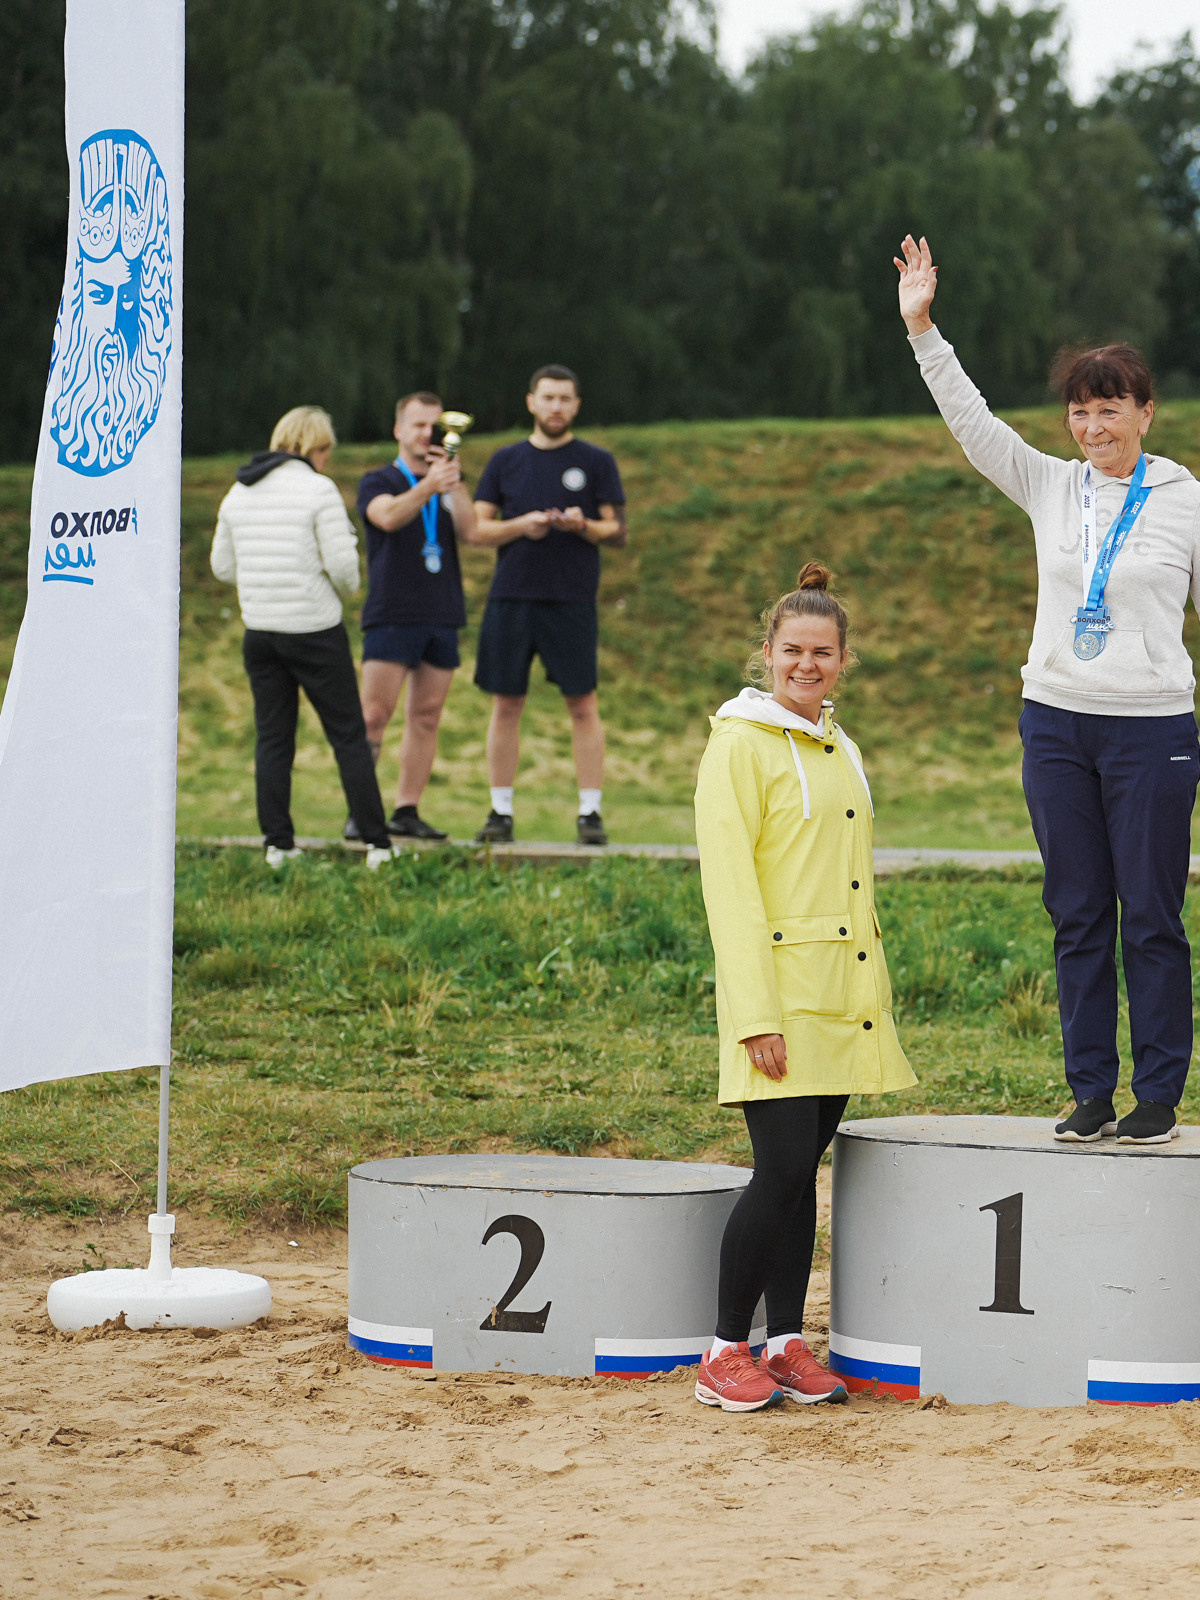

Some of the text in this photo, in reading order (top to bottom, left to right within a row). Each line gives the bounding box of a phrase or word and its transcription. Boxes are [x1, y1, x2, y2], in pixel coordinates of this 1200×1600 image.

[1131, 501, 1142, 515] 2023
[480, 1214, 552, 1333] 2
[979, 1192, 1034, 1315] 1
